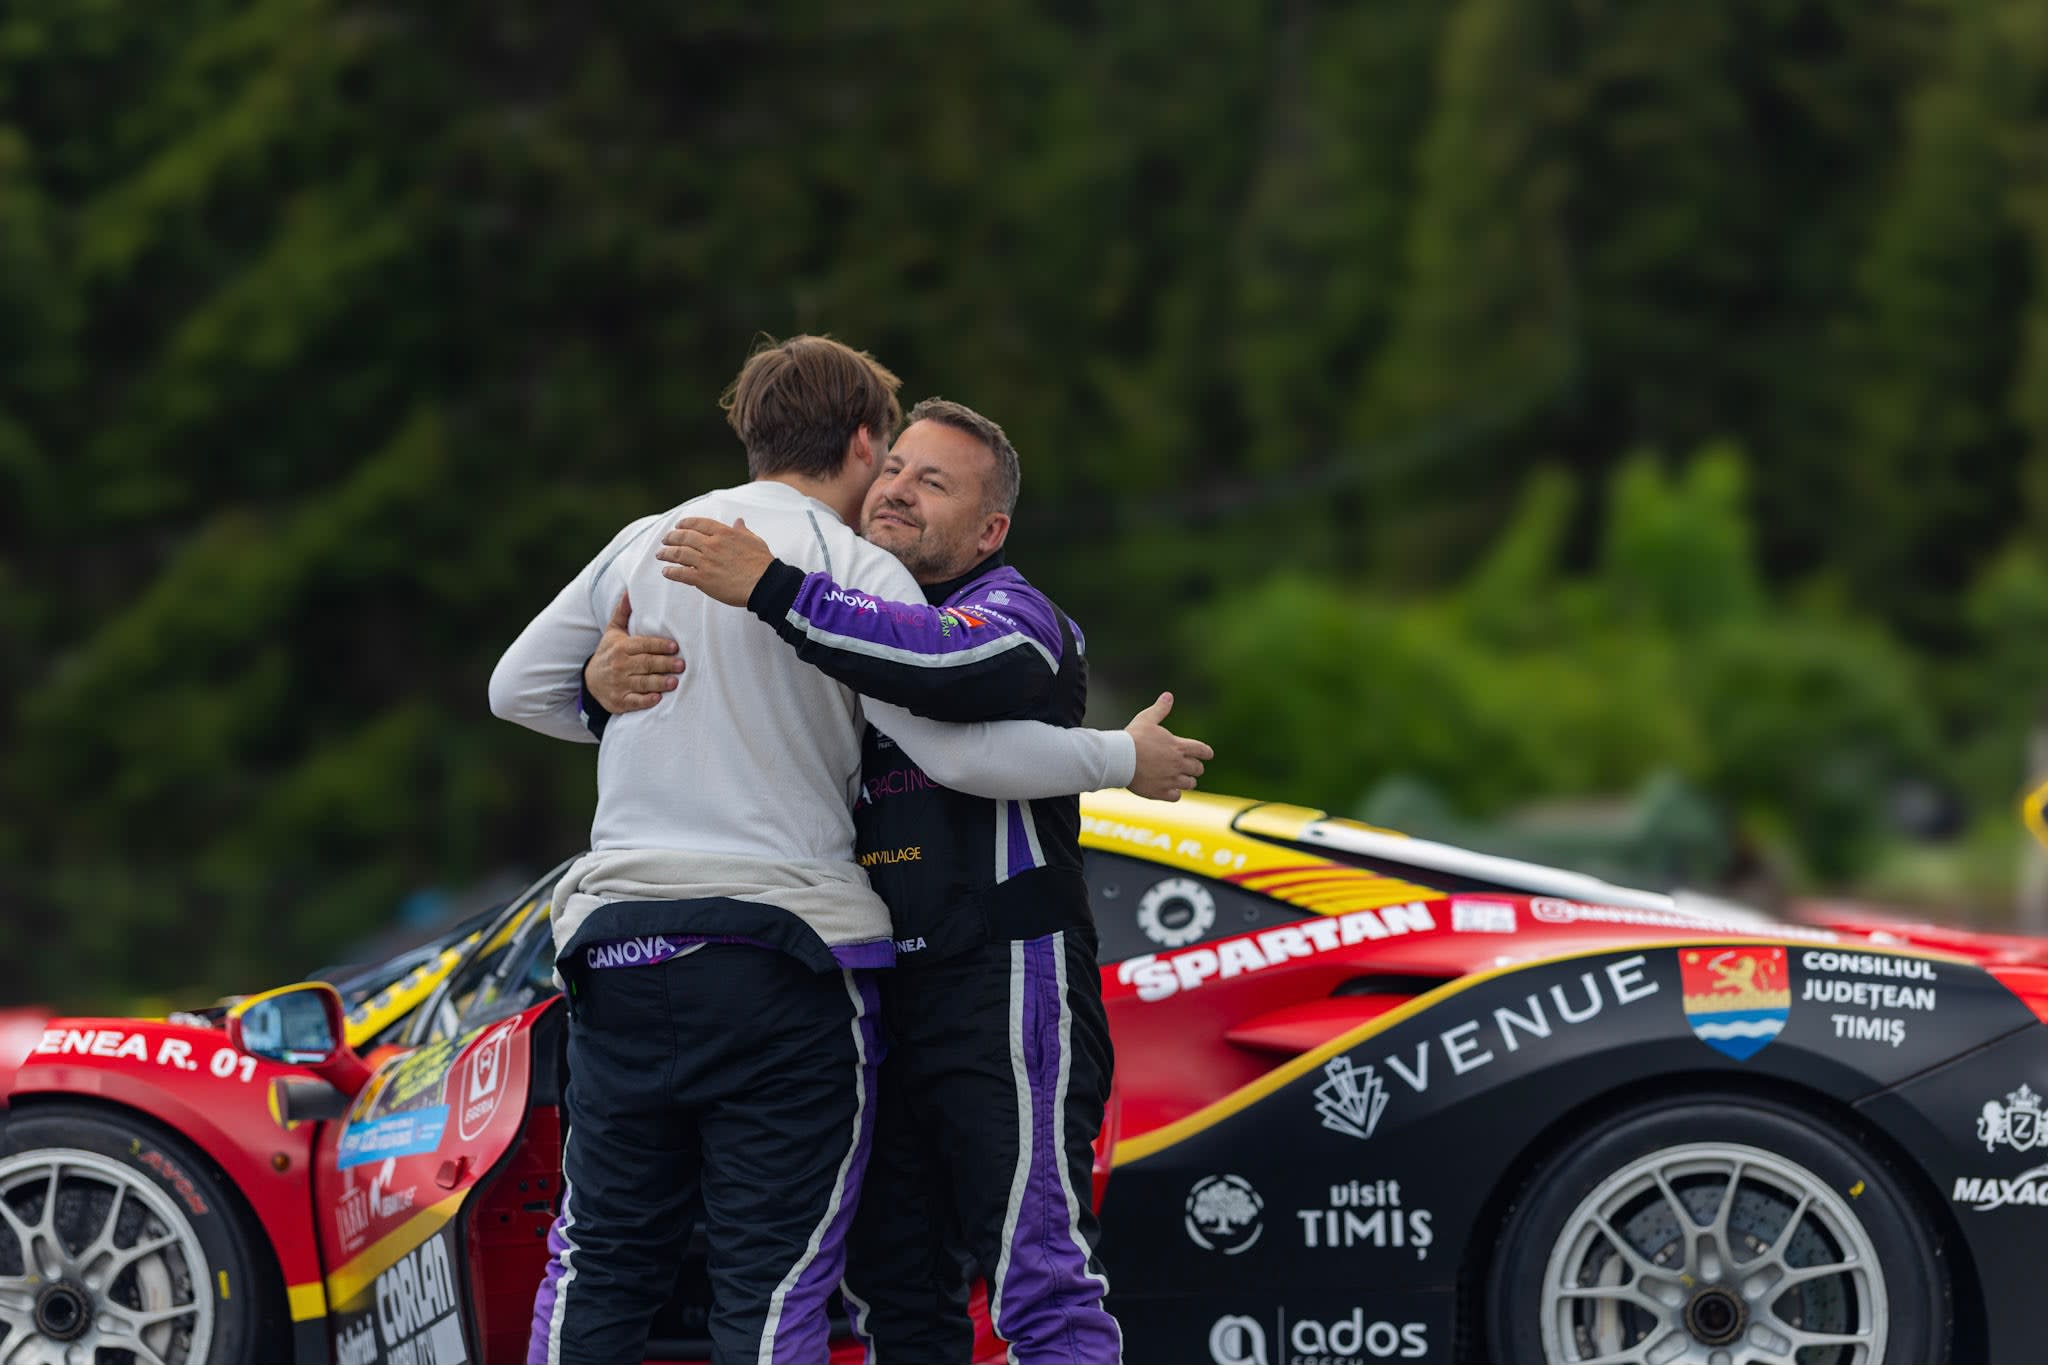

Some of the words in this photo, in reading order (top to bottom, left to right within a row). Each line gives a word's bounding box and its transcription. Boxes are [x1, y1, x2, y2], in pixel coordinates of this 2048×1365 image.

[823, 590, 878, 614] ANOVA
[861, 846, 922, 865] ANVILLAGE
[587, 935, 676, 969] CANOVA
[895, 937, 927, 953] NEA
[1117, 901, 1436, 1002] SPARTAN
[1802, 951, 1937, 981] CONSILIUL
[1384, 955, 1660, 1092] VENUE
[156, 1038, 198, 1071] R.
[210, 1047, 257, 1082] 01
[1329, 1179, 1401, 1207] visit
[1297, 1209, 1434, 1261] TIMIȘ
[1291, 1307, 1428, 1358] ados
